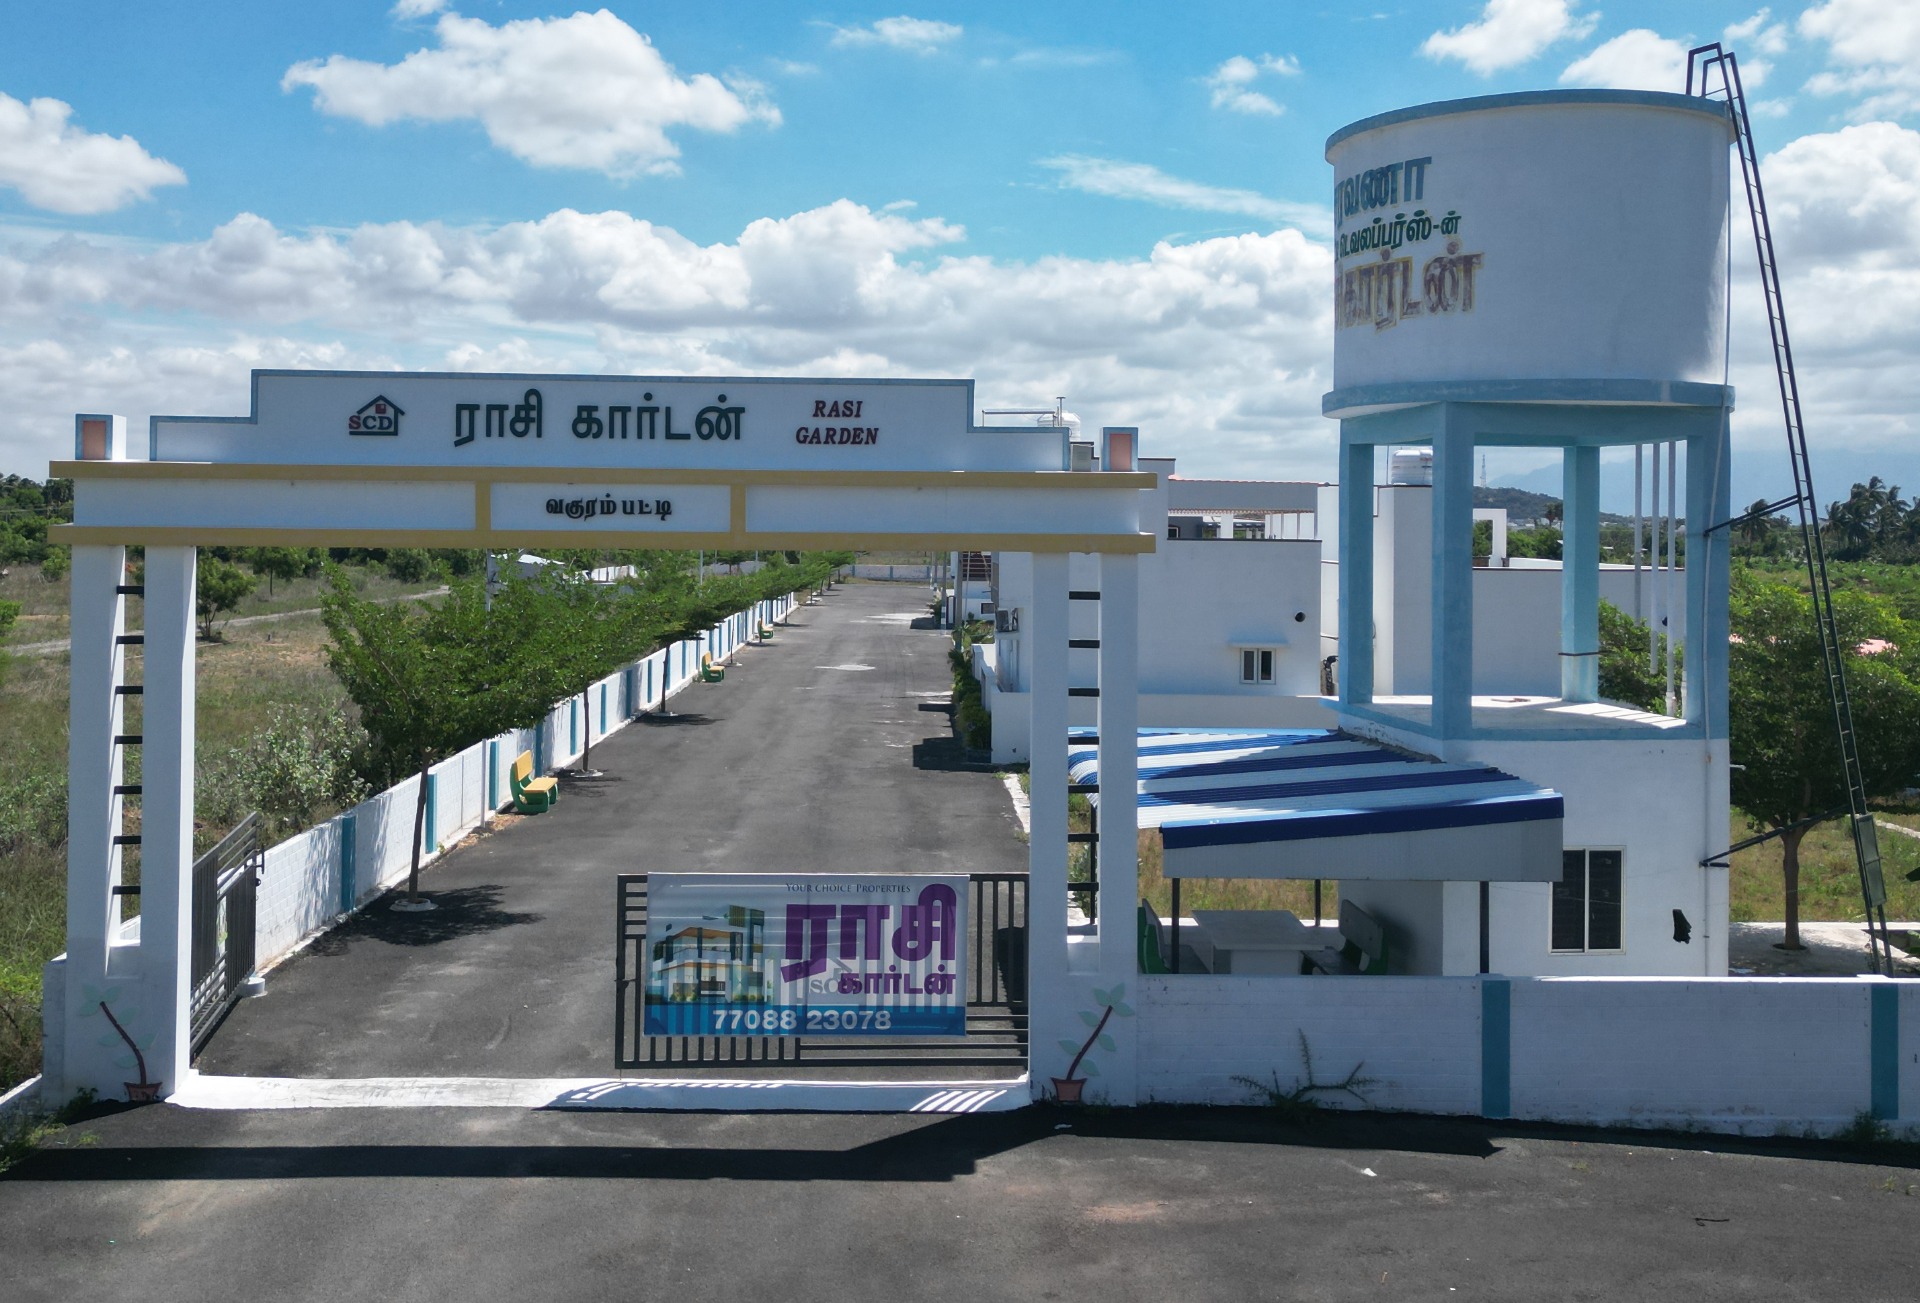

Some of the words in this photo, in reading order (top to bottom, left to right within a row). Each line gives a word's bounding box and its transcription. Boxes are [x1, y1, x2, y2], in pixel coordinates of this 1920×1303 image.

[454, 388, 543, 447] ராசி
[572, 392, 746, 441] கார்டன்
[812, 400, 863, 418] RASI
[349, 415, 393, 431] SCD
[795, 427, 879, 445] GARDEN
[780, 883, 957, 984] ராசி
[838, 963, 957, 996] கார்டன்
[713, 1009, 797, 1031] 77088
[806, 1009, 892, 1031] 23078
